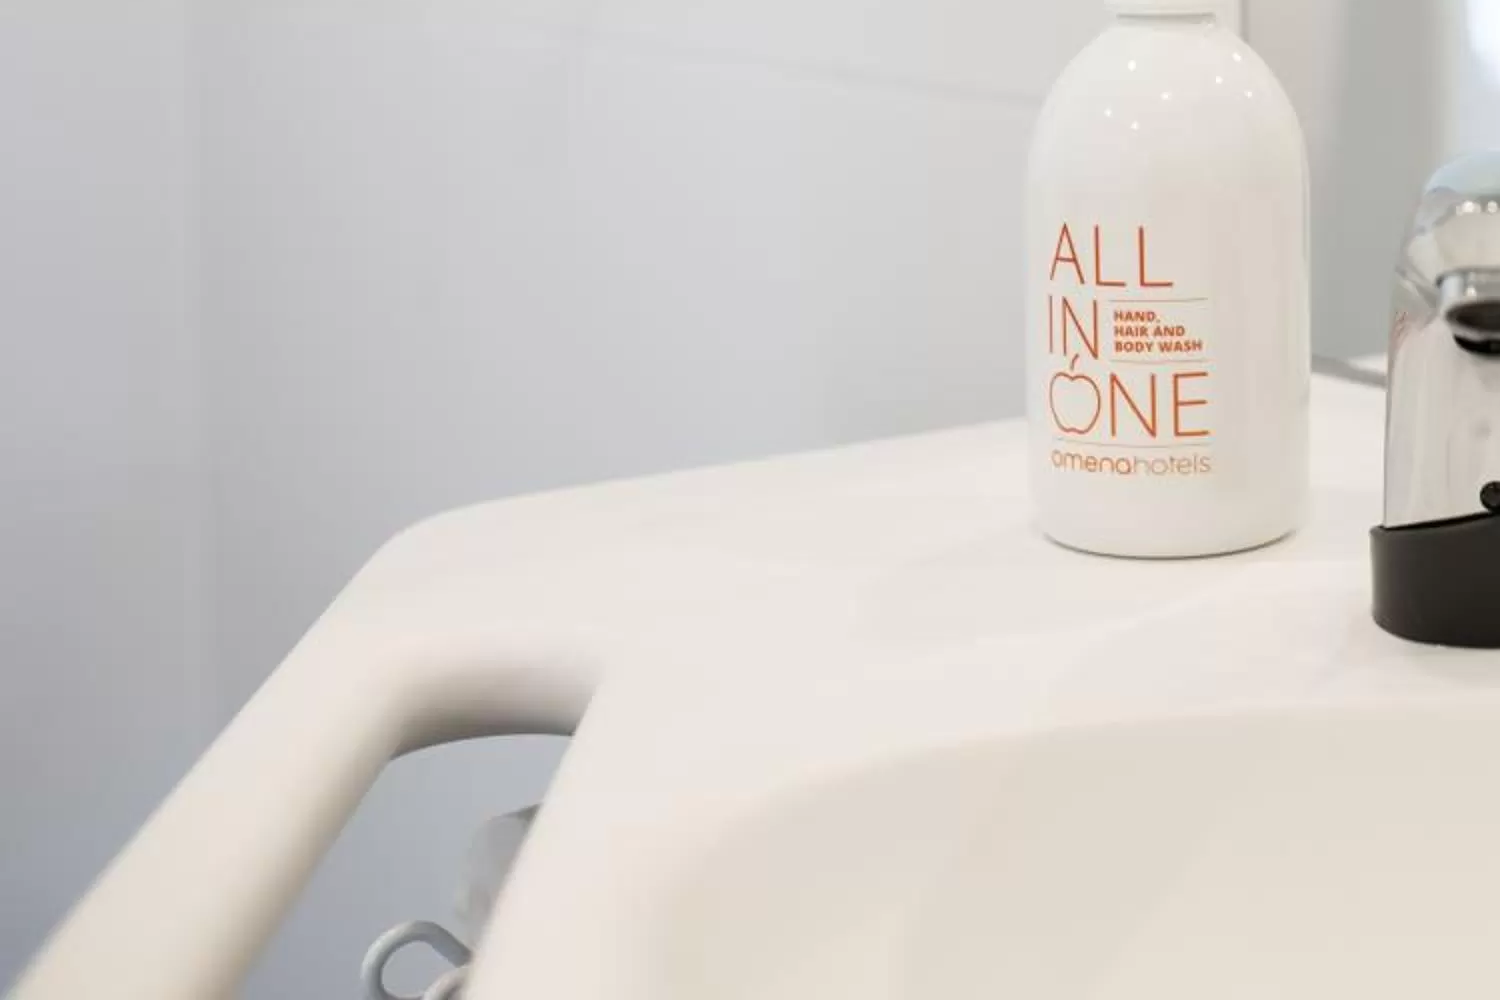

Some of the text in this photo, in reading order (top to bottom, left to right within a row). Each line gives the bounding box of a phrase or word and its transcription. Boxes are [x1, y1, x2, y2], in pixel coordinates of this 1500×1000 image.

[1050, 222, 1173, 286] ALL
[1049, 294, 1098, 360] IN
[1113, 311, 1160, 323] HAND,
[1113, 325, 1185, 337] HAIR AND
[1114, 339, 1203, 353] BODY WASH
[1049, 370, 1210, 438] ONE
[1050, 449, 1212, 475] omenahotels
